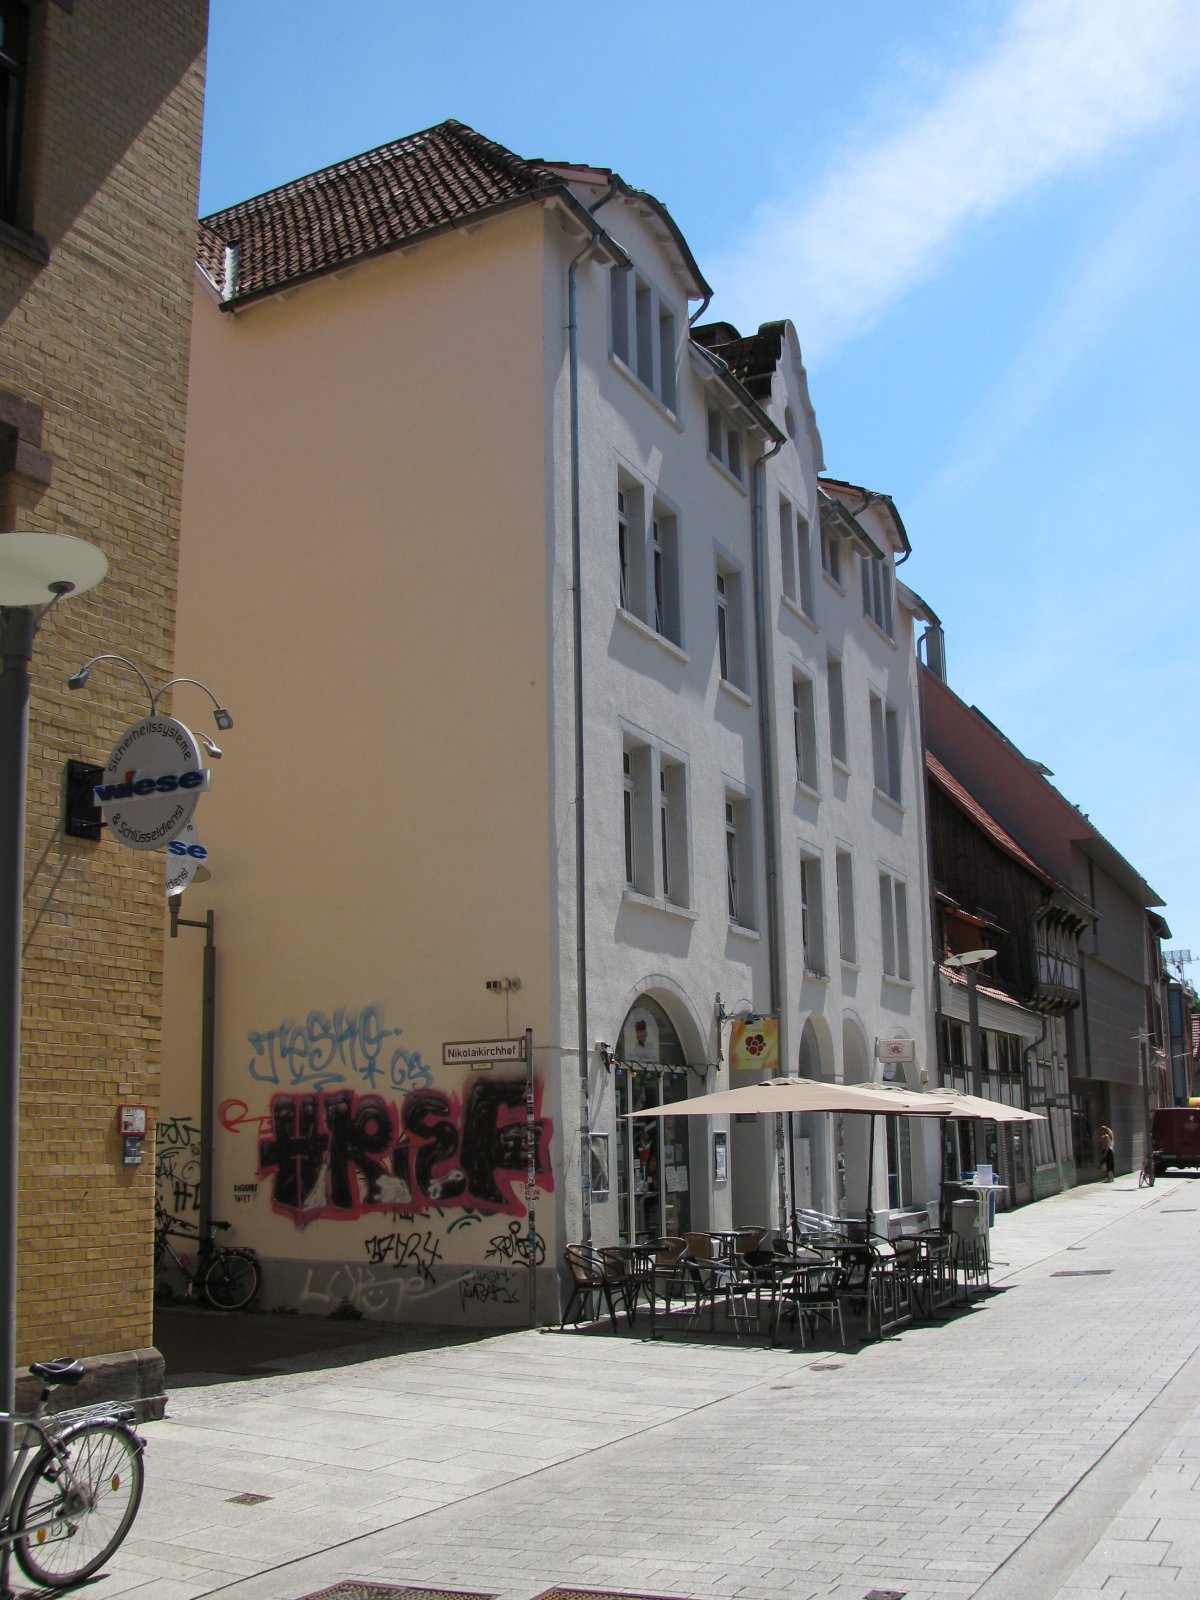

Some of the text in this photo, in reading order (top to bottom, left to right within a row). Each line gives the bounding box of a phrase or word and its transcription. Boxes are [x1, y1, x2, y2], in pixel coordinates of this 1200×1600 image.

[108, 721, 192, 774] Sicherheitssysteme
[95, 770, 204, 801] wiese
[112, 804, 184, 843] & Schlüsseldienst
[447, 1045, 517, 1058] Nikolaikirchhof
